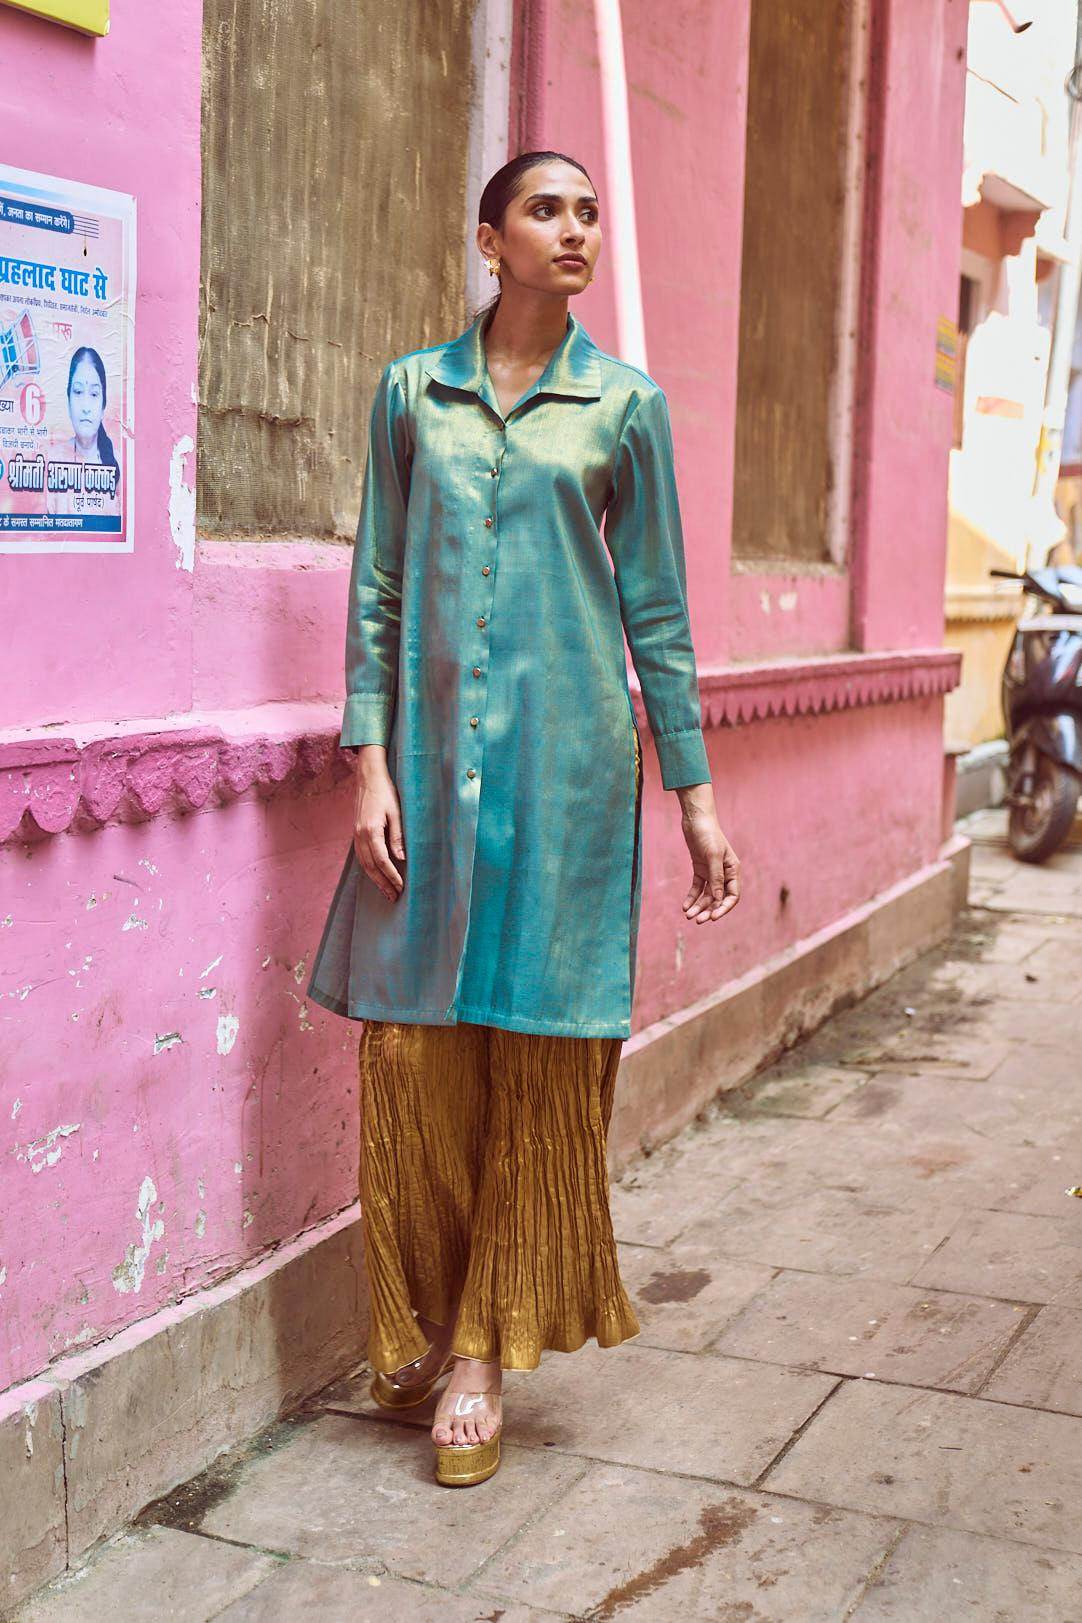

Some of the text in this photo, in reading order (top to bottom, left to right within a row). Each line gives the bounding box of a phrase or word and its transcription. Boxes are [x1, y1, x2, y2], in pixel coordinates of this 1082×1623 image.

[24, 210, 33, 221] का
[59, 268, 90, 297] घाट
[92, 267, 108, 300] से
[25, 384, 41, 424] 6
[8, 453, 45, 492] श्रीमती
